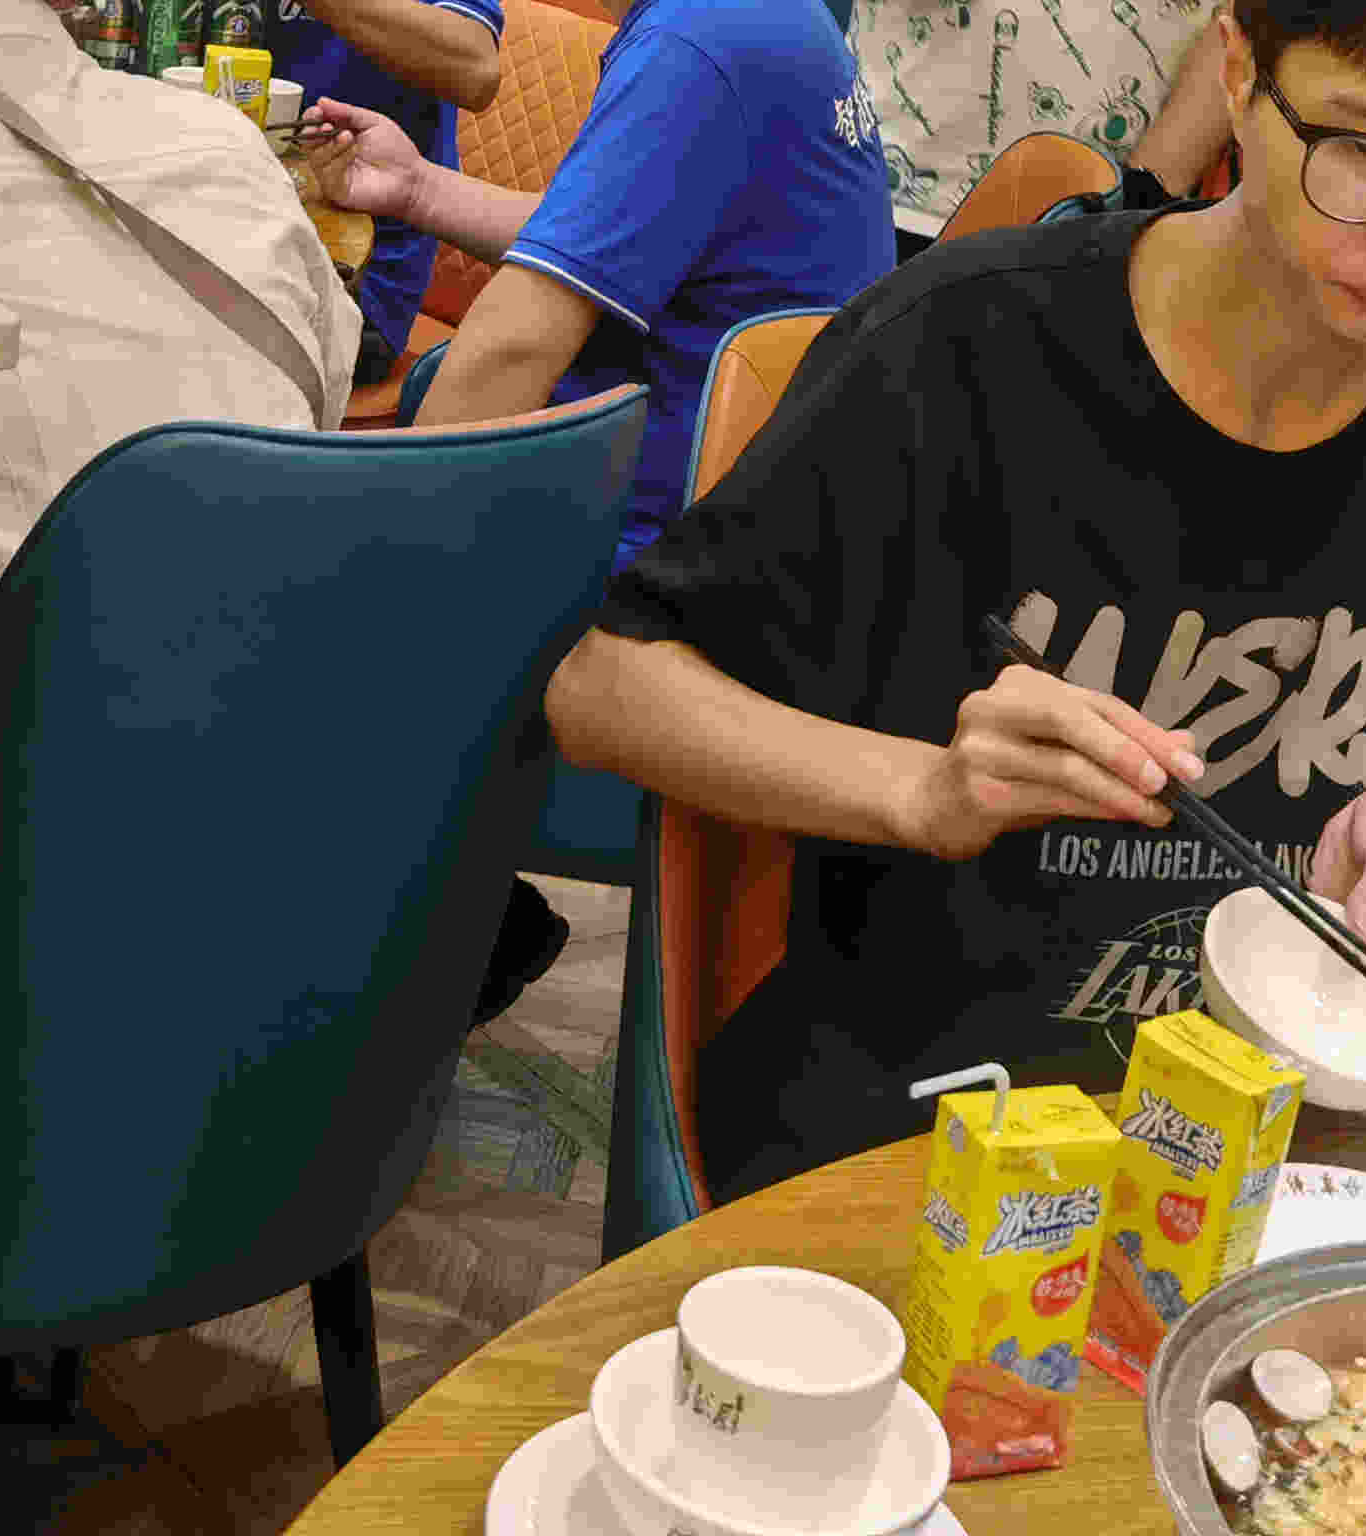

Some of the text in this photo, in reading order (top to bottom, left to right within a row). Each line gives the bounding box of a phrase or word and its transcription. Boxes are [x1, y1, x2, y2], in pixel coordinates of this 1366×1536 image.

[1038, 830, 1102, 878] LOS
[1147, 943, 1199, 963] LOS
[1120, 1086, 1225, 1176] 冰红茶
[981, 1183, 1103, 1257] 冰红茶
